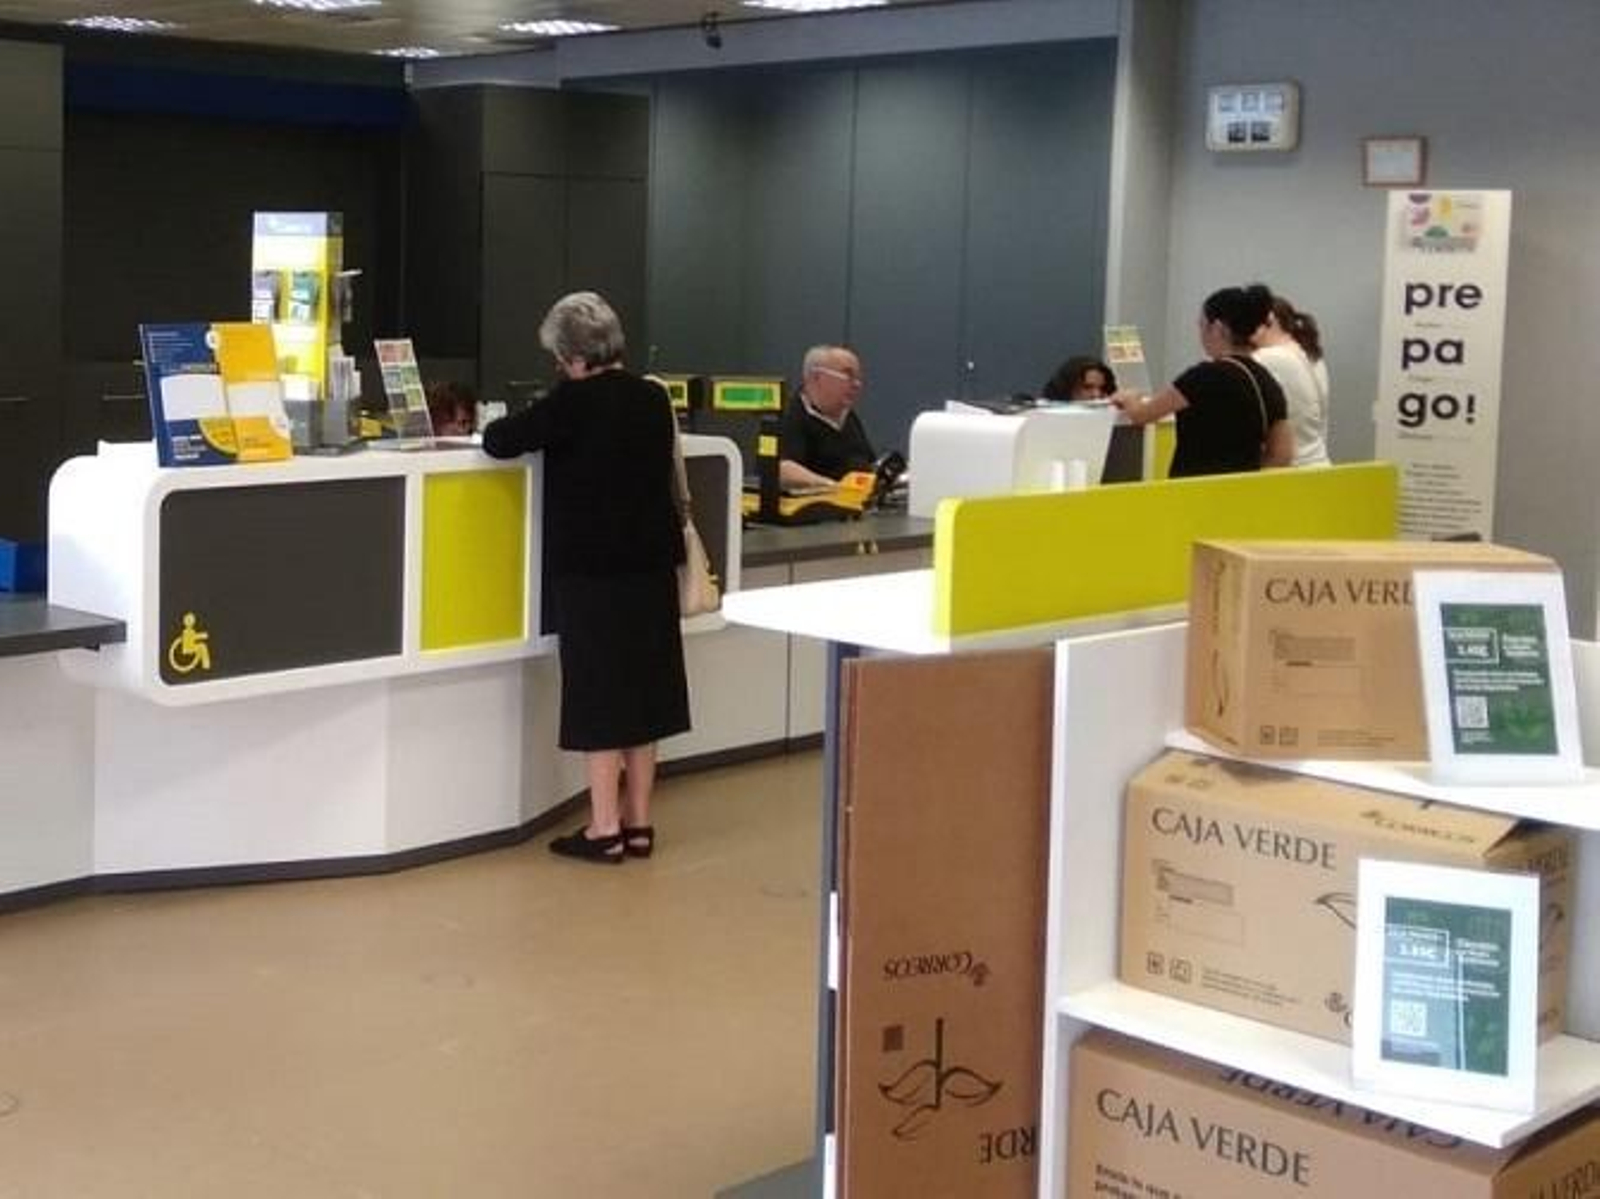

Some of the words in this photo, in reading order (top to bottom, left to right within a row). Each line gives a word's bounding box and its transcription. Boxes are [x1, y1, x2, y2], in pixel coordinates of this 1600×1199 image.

[1404, 282, 1483, 316] pre
[1402, 337, 1465, 371] pa
[1397, 392, 1476, 428] go!
[1265, 578, 1337, 606] CAJA
[1152, 806, 1225, 846] CAJA
[1233, 823, 1338, 872] VERDE
[883, 951, 973, 980] CORREOS
[1096, 1087, 1181, 1143] CAJA
[1190, 1116, 1311, 1188] VERDE
